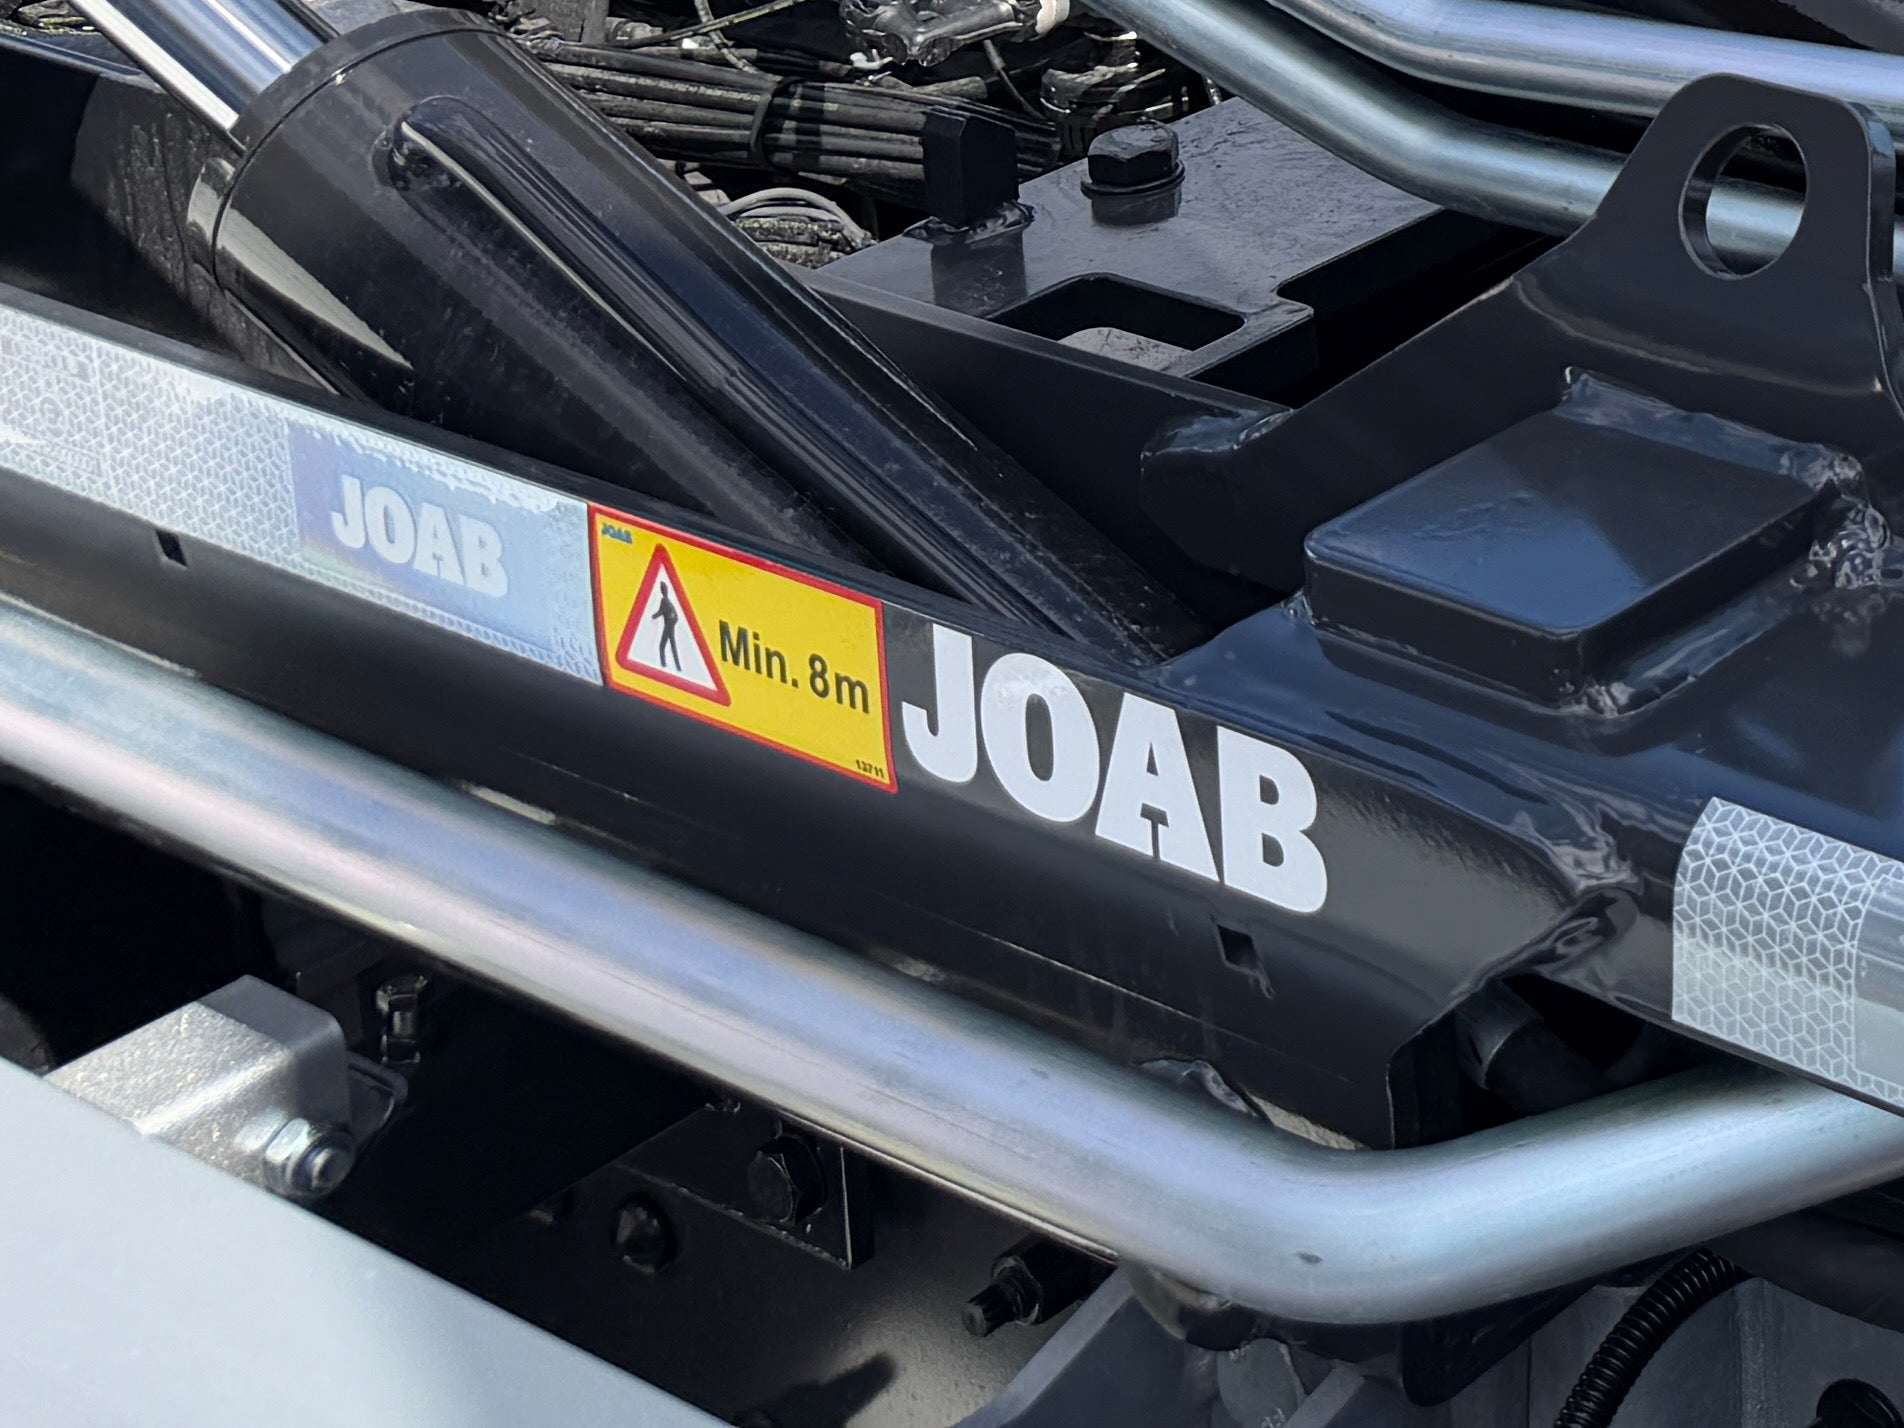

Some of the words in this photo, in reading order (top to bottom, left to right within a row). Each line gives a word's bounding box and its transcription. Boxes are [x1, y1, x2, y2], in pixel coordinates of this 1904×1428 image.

[330, 474, 509, 599] JOAB
[718, 618, 800, 690] Min.
[901, 622, 1328, 913] JOAB
